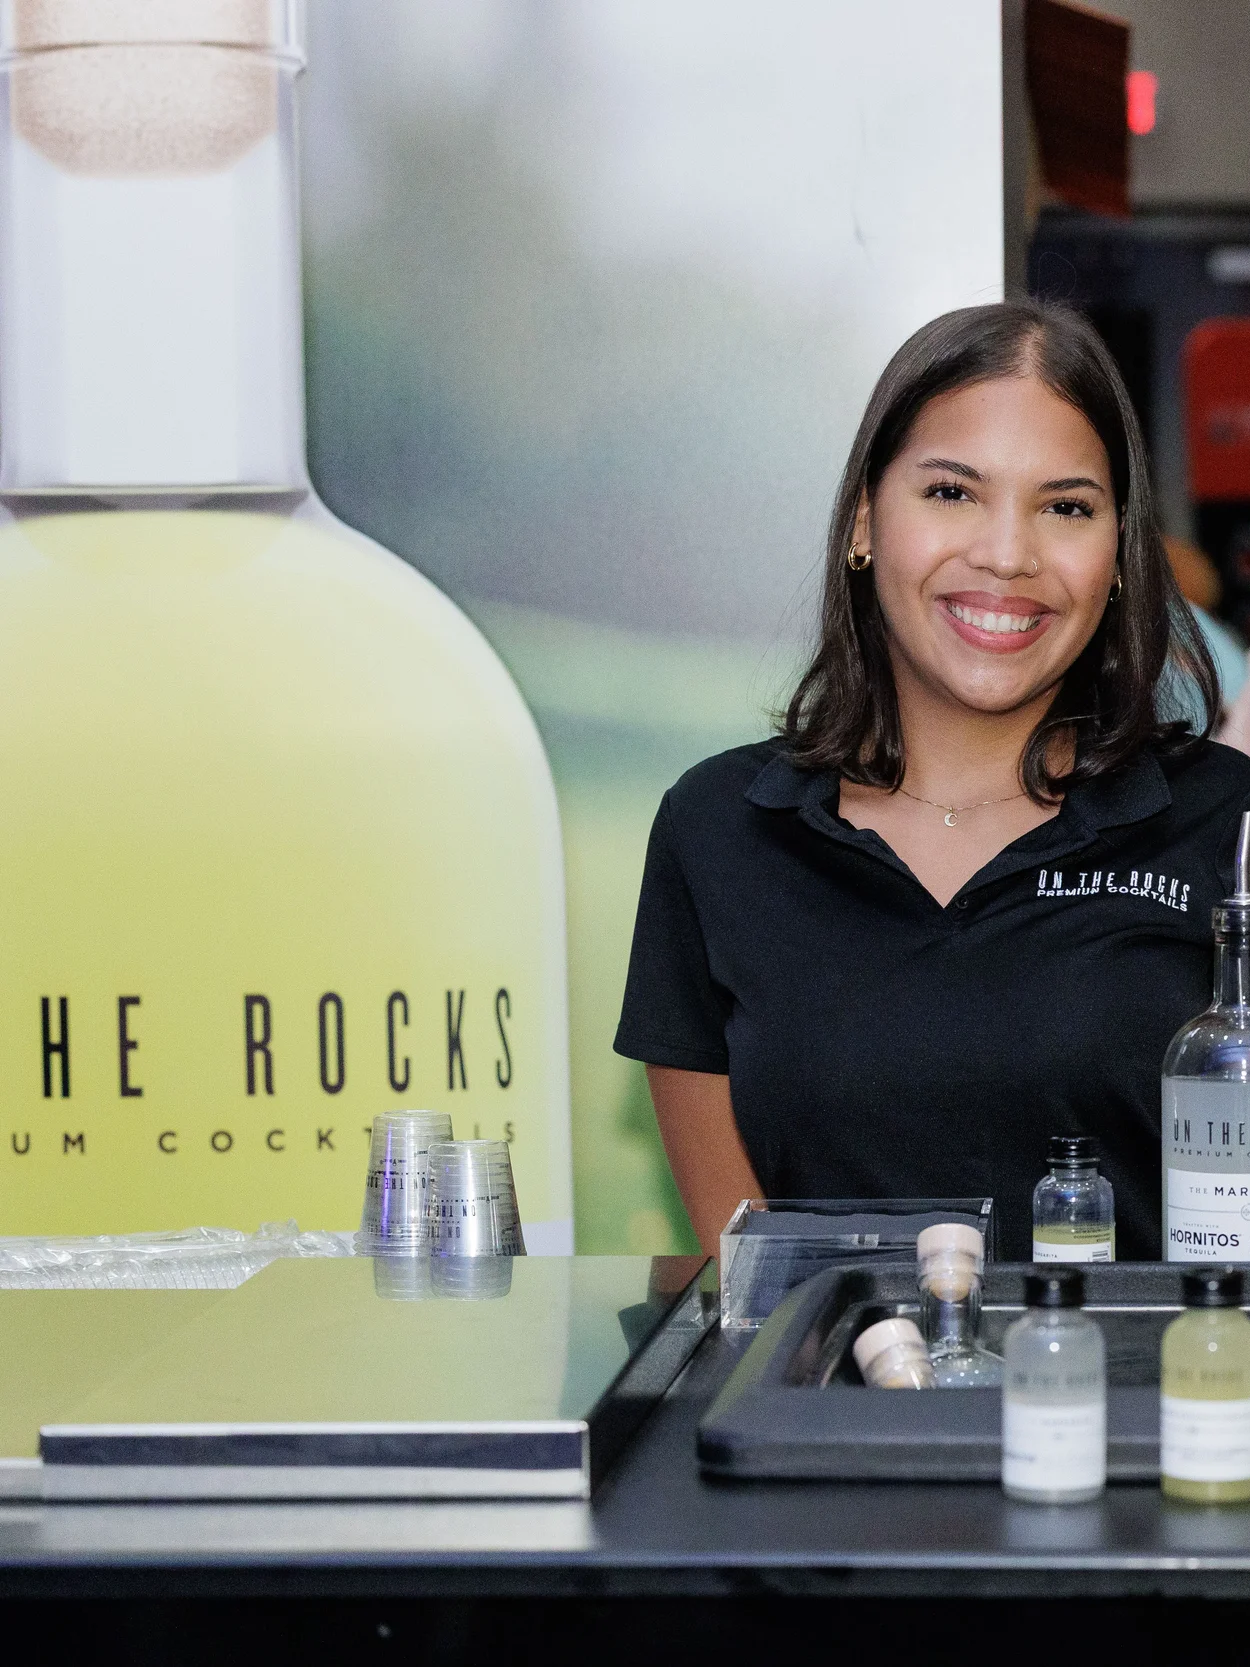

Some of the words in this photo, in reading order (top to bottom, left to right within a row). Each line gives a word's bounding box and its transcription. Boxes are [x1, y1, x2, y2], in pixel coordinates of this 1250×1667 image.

[1038, 869, 1063, 889] ON
[1079, 871, 1116, 888] THE
[1130, 870, 1191, 903] ROCKS
[1107, 886, 1189, 912] COCKTAILS
[243, 986, 513, 1097] ROCKS
[11, 1130, 86, 1156] UM
[1173, 1117, 1191, 1143] ON
[1207, 1121, 1246, 1146] THE
[1173, 1147, 1233, 1158] PREMIUM
[1189, 1186, 1209, 1195] THE
[1170, 1227, 1240, 1247] HORNITOS
[1185, 1247, 1217, 1256] TEQUILA
